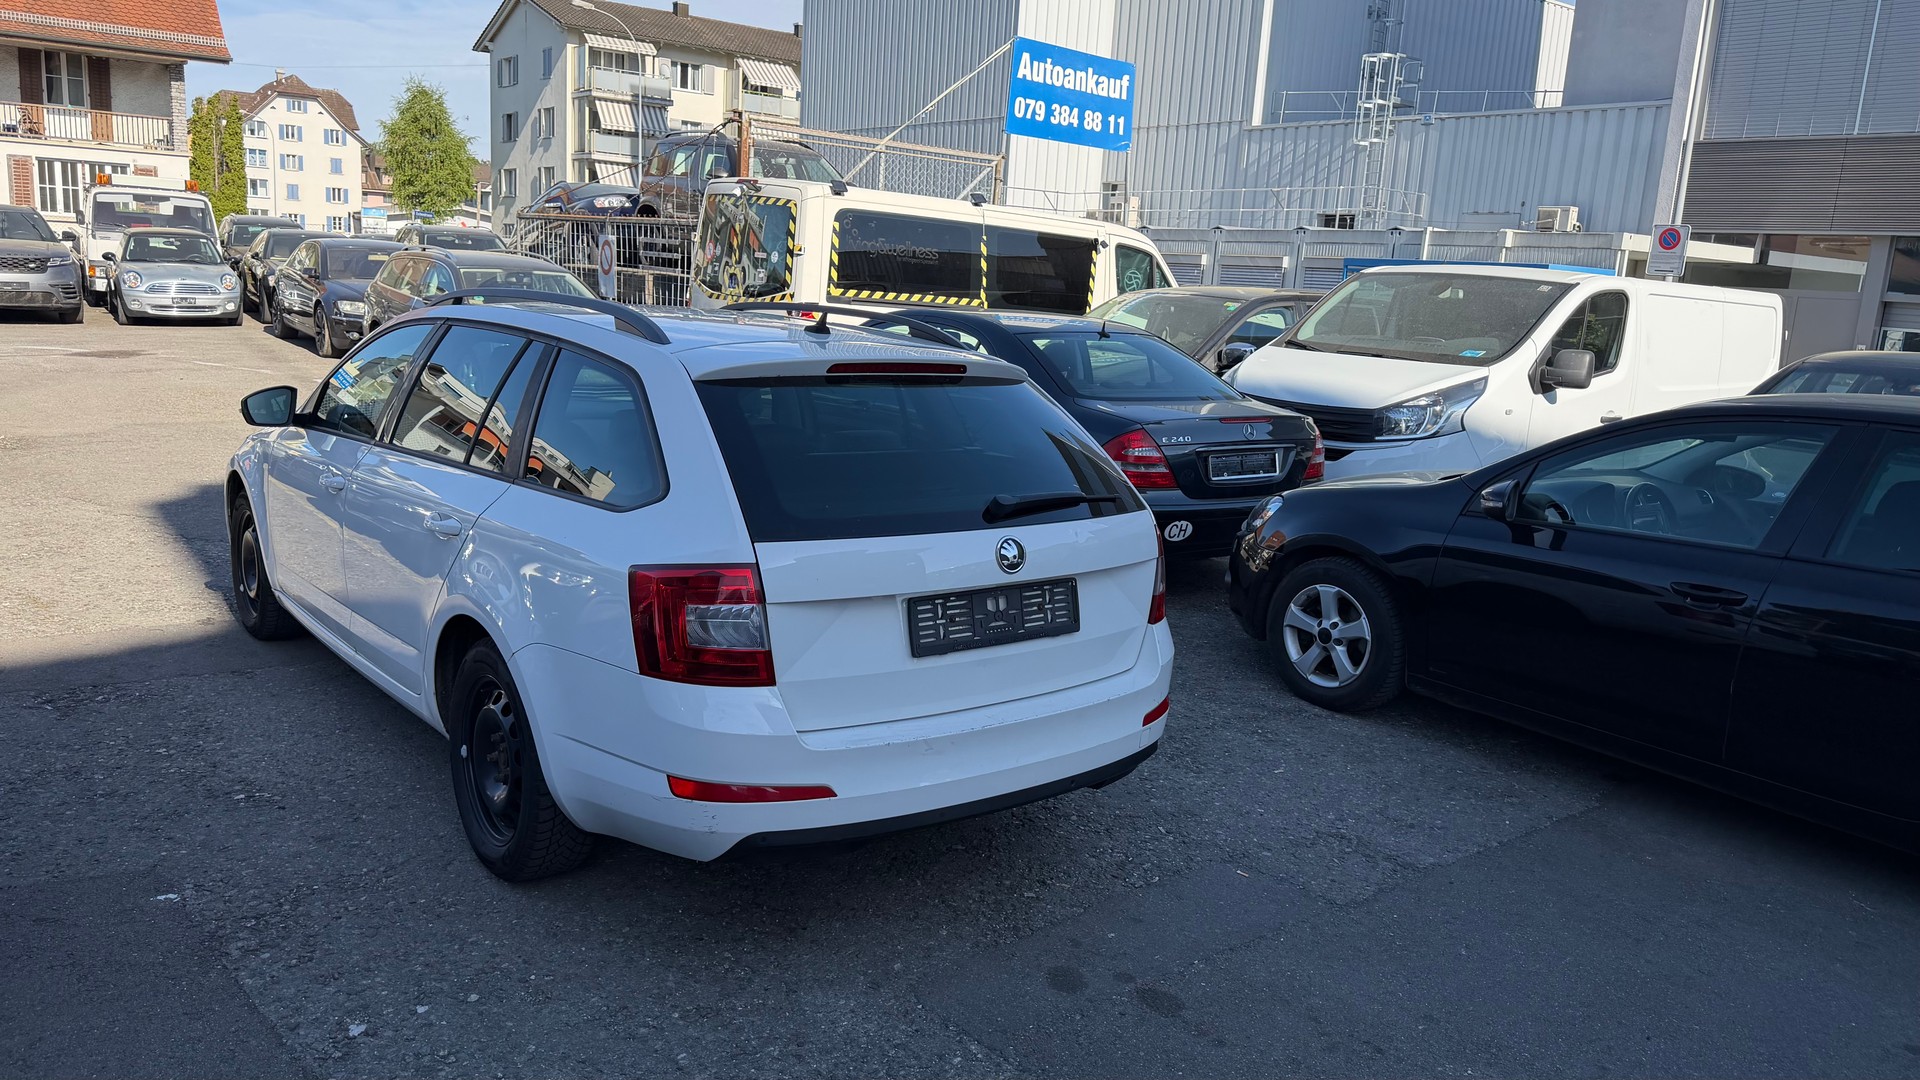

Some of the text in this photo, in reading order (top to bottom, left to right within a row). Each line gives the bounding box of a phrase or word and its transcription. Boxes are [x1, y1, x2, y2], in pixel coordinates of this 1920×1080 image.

[1016, 51, 1130, 100] Autoankauf
[1014, 96, 1125, 136] 079 384 88 11
[1171, 435, 1192, 443] 240
[1167, 523, 1189, 539] CH
